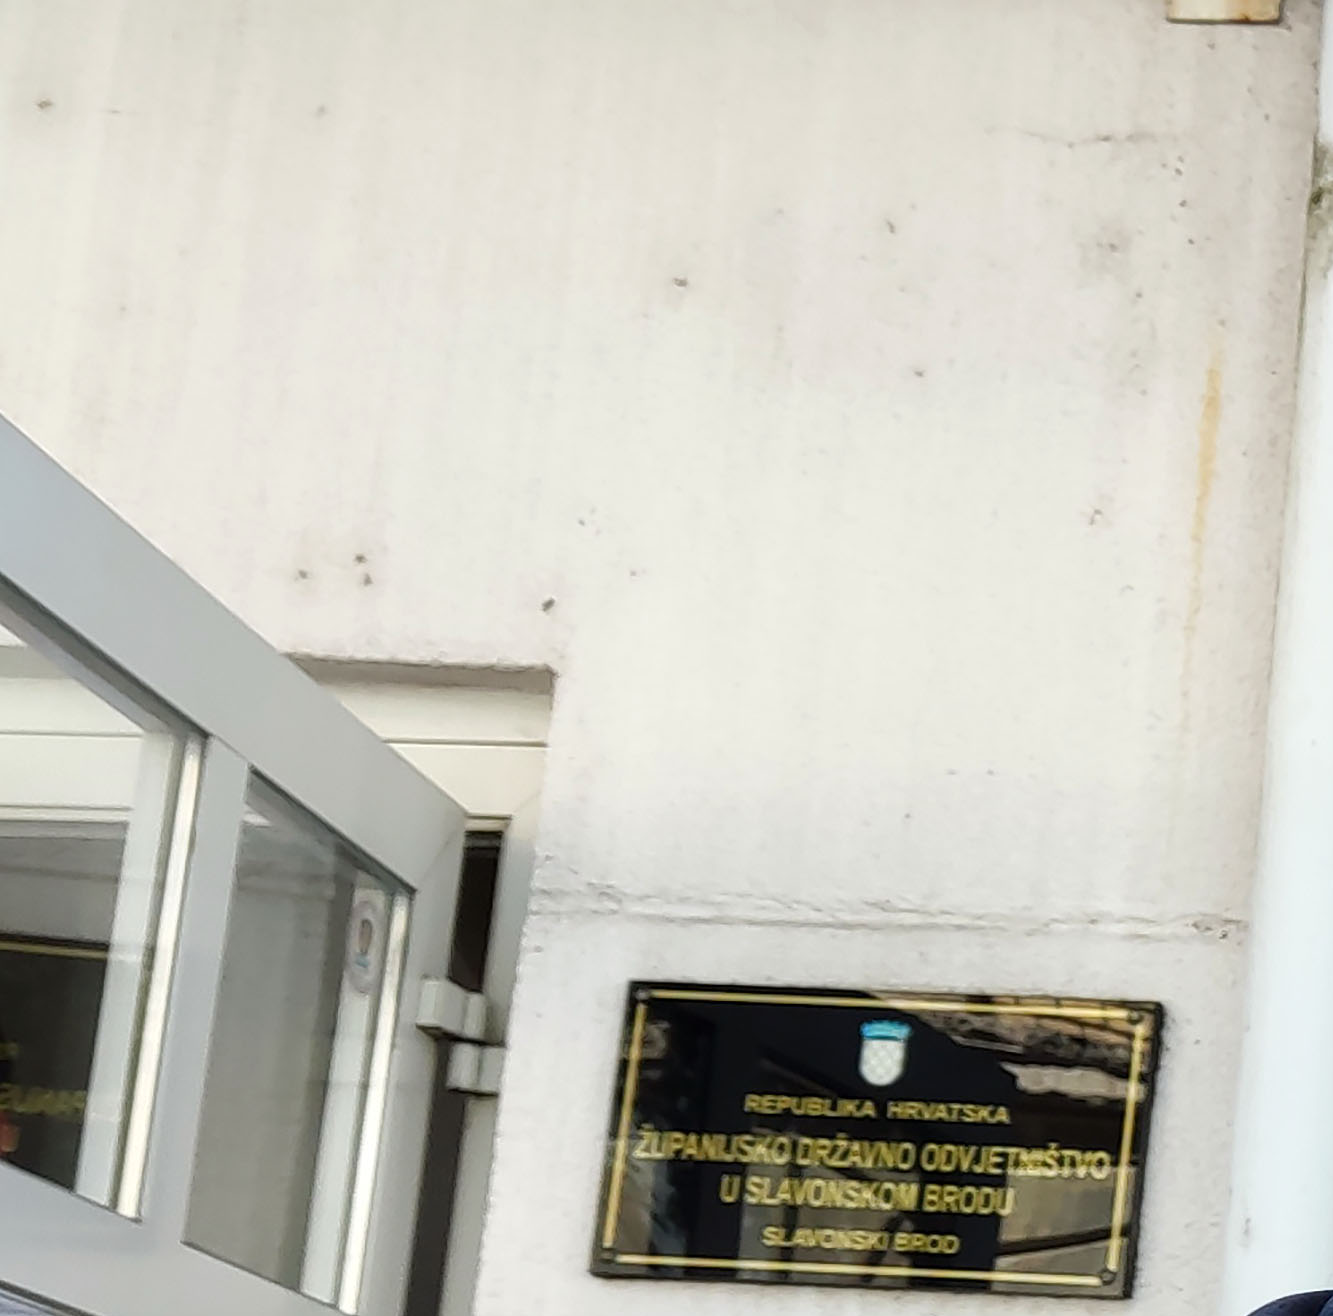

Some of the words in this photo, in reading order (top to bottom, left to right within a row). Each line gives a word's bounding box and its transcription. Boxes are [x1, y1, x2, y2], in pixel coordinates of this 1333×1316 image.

[743, 1093, 877, 1118] REPUBLIKA
[886, 1100, 1012, 1125] HRVATSKA
[631, 1123, 792, 1166] ŽUPANIJSKO
[796, 1132, 916, 1172] DRŽAVNO
[920, 1142, 1111, 1180] ODVJETNIŠTVO
[719, 1174, 741, 1203] U
[743, 1176, 920, 1211] SLAVONSKOM
[922, 1184, 1016, 1216] BRODU
[761, 1225, 889, 1251] SLAVONSKI
[894, 1232, 960, 1255] BROD
